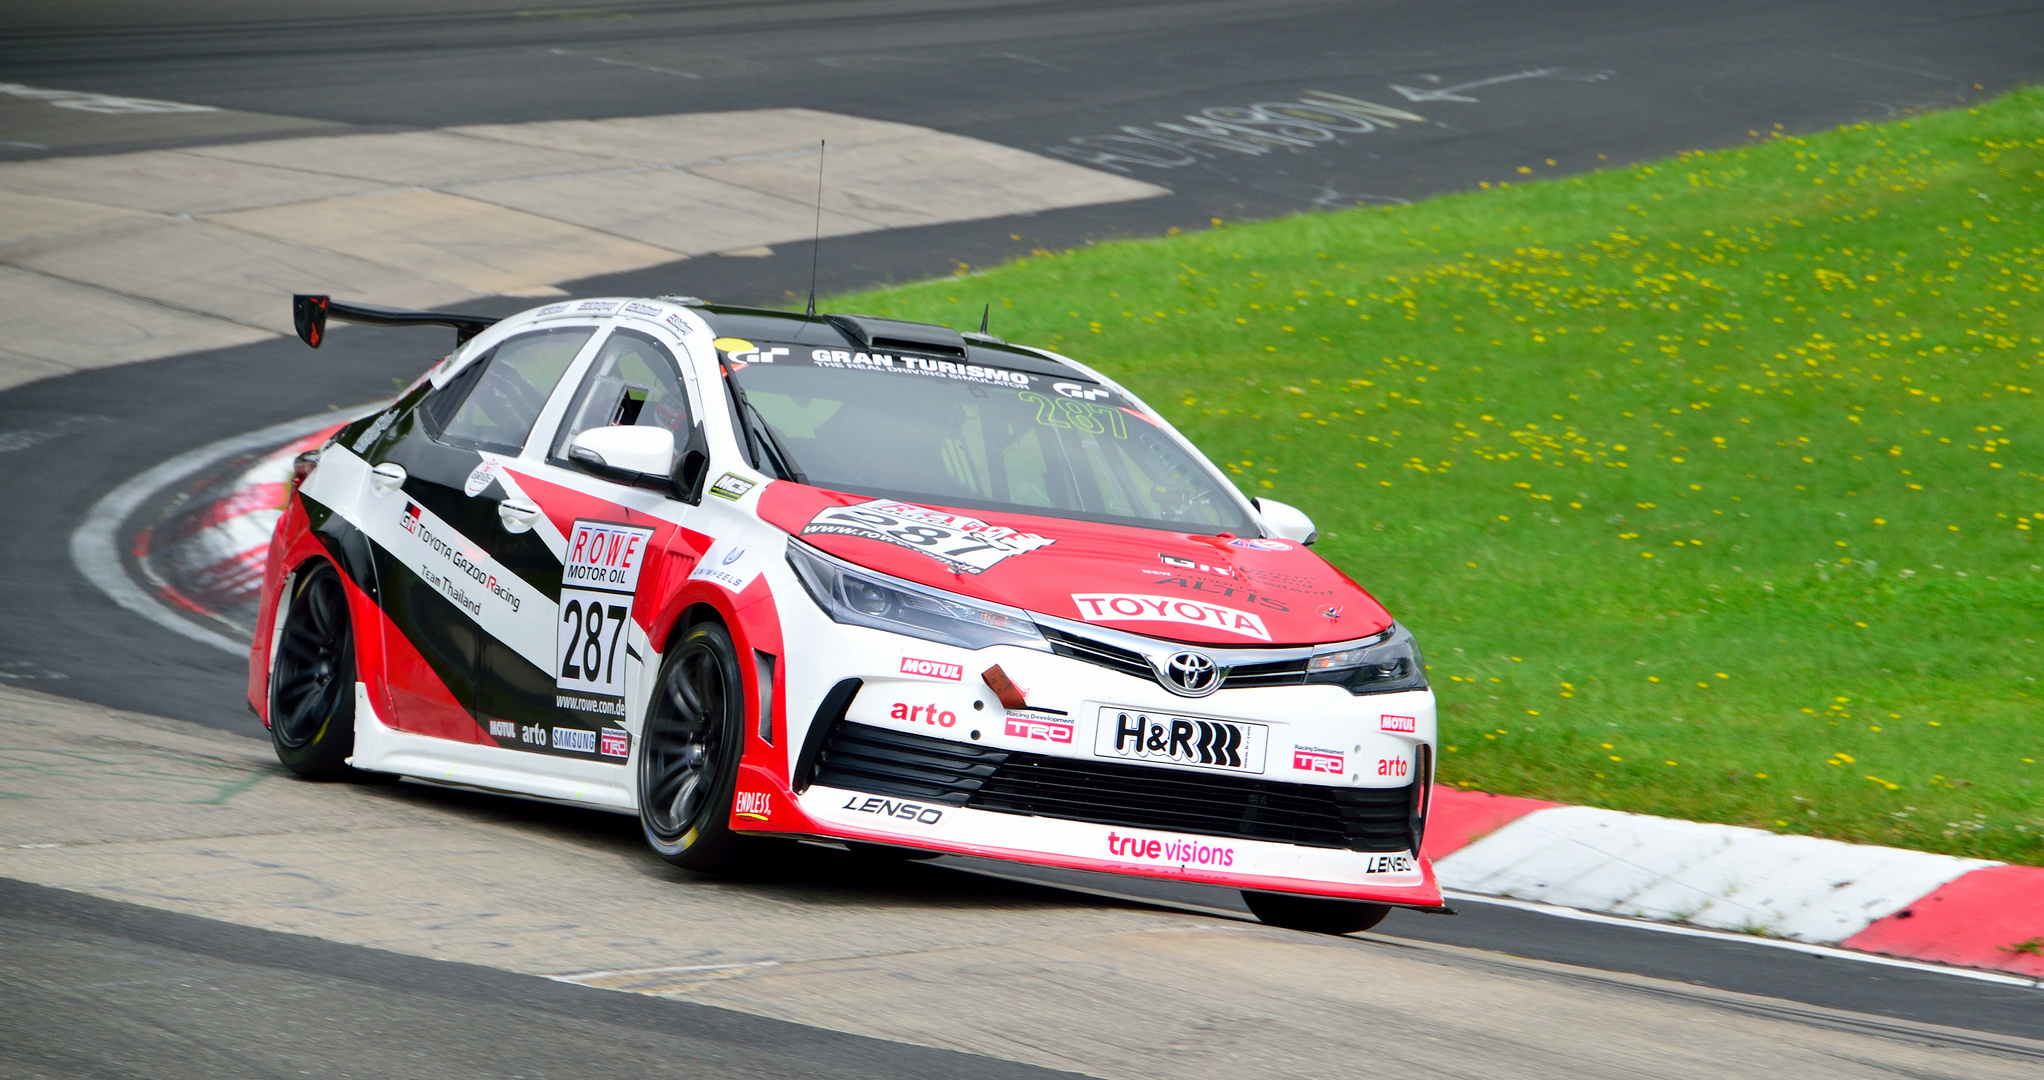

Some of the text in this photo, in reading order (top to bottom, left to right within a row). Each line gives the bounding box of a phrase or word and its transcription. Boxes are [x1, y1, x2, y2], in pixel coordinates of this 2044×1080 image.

[811, 349, 1030, 385] GRAN TURISMO
[846, 362, 886, 371] REAL
[886, 365, 947, 378] DRIVING
[948, 372, 1031, 390] SIMULATOR
[1017, 391, 1128, 439] 287
[825, 512, 997, 557] 287
[571, 530, 640, 568] ROWE
[417, 523, 453, 560] TOYOTA
[452, 551, 487, 584] GAZOO
[486, 574, 521, 612] Racing
[567, 564, 626, 584] MOTOR OIL
[442, 575, 481, 616] Thailand
[1154, 576, 1290, 612] ALTIS
[1078, 597, 1264, 636] TOYOTA
[561, 599, 628, 684] 287
[902, 659, 961, 679] MOTUL
[556, 695, 625, 717] www.rowe.com.de
[890, 702, 957, 728] arto
[1006, 710, 1075, 724] Racing Development
[490, 720, 517, 738] MOTUL
[522, 722, 547, 746] arto
[1007, 720, 1071, 742] TRD
[1115, 714, 1194, 758] H&R
[1382, 716, 1415, 731] MOTUL
[553, 729, 595, 750] SAMSUNG
[602, 738, 627, 755] TRD
[1295, 754, 1343, 773] TRD
[1378, 755, 1408, 777] arto
[735, 791, 771, 814] ENDLESS
[842, 796, 943, 825] LENSO
[1107, 831, 1234, 867] true visions
